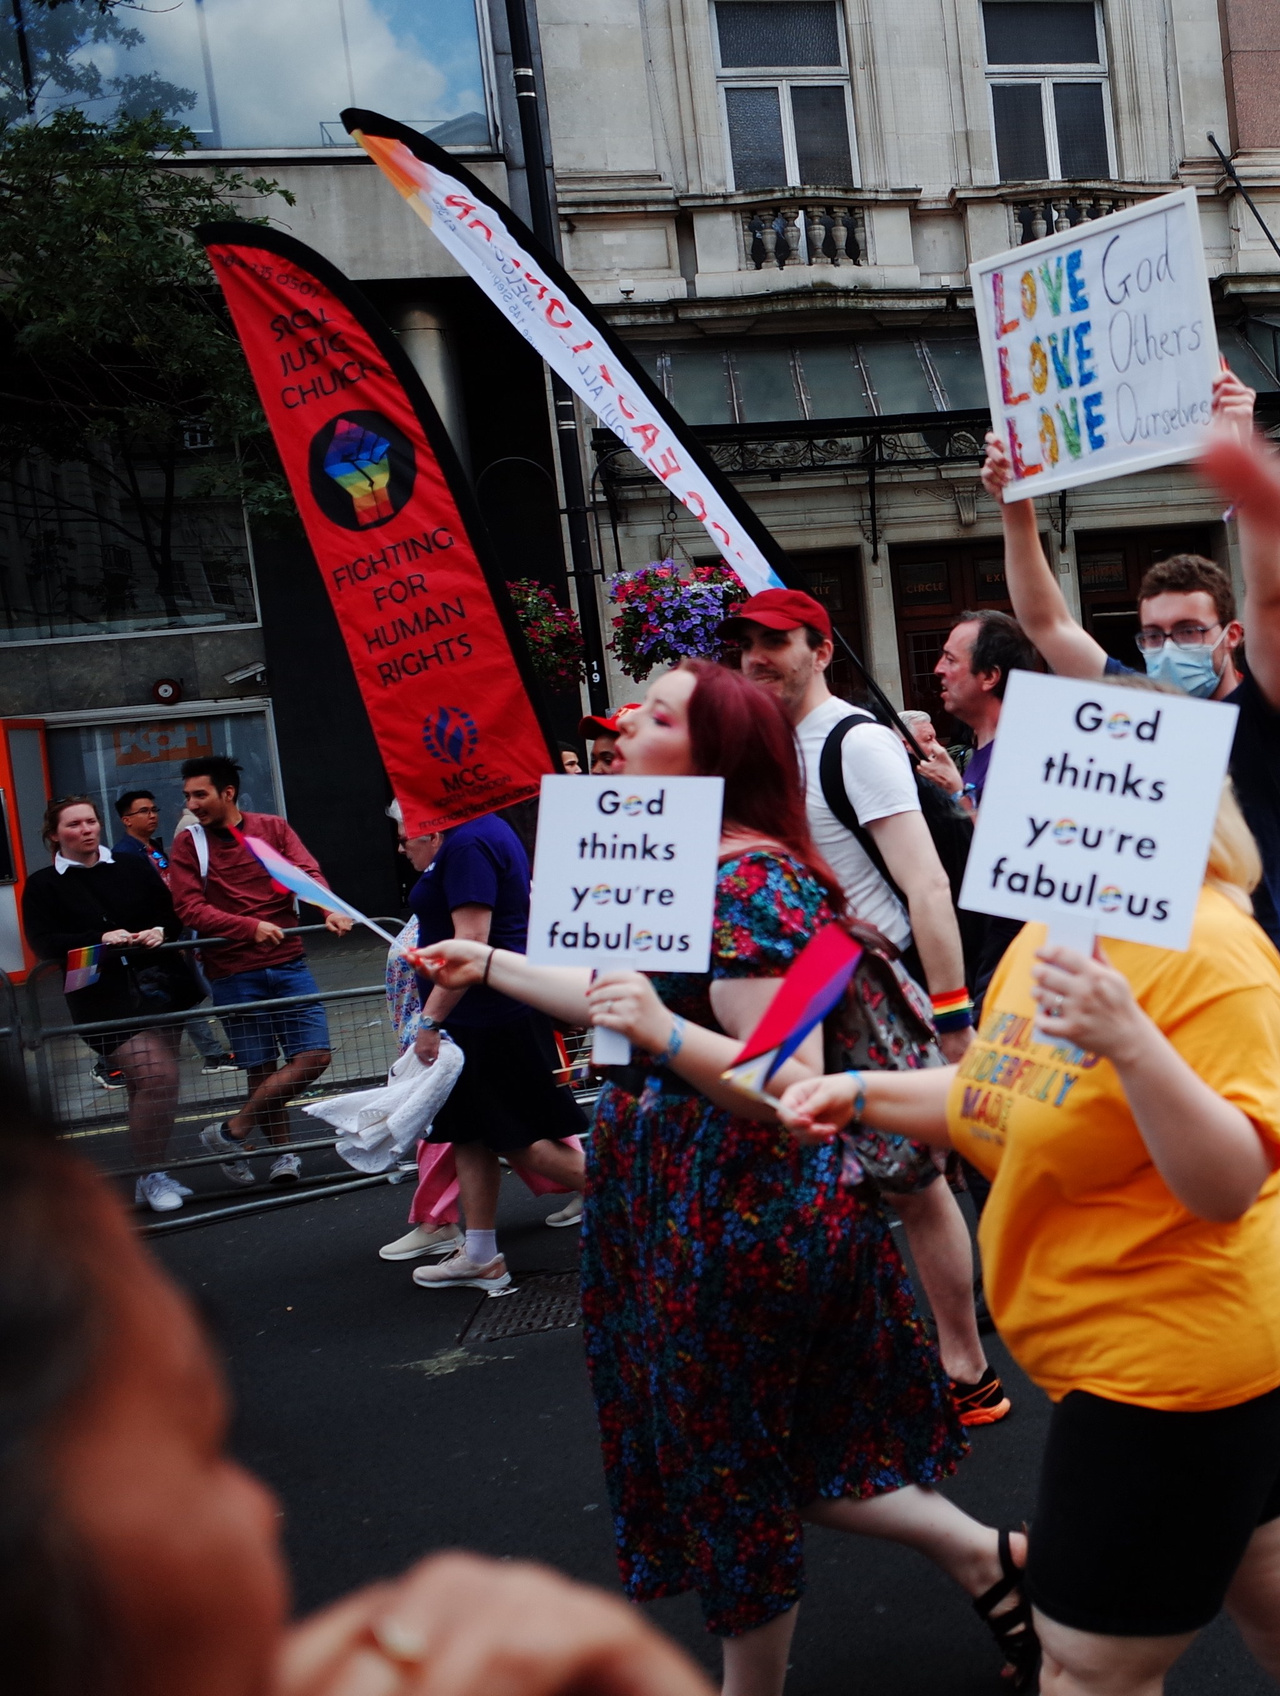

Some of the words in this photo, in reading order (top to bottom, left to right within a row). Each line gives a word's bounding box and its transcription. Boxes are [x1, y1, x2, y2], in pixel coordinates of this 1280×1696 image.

[993, 249, 1089, 340] LOVE
[1102, 213, 1175, 305] God
[998, 321, 1097, 405] LOVE
[1108, 309, 1202, 374] Others
[1006, 391, 1107, 481] LOVE
[1116, 381, 1211, 444] Ourselves
[332, 527, 455, 592] FIGHTING
[373, 573, 428, 611] FOR
[809, 585, 830, 596] XIT
[906, 581, 945, 594] CIRCLE
[362, 597, 467, 654] HUMAN
[377, 633, 473, 687] RIGHTS
[1075, 702, 1161, 741] God
[441, 763, 488, 793] MCC
[1043, 753, 1165, 801] thinks
[598, 789, 665, 816] God
[579, 833, 675, 861] thinks
[1027, 817, 1156, 859] you're
[572, 884, 674, 912] you're
[992, 857, 1169, 921] fabulous
[548, 922, 690, 952] fabulous
